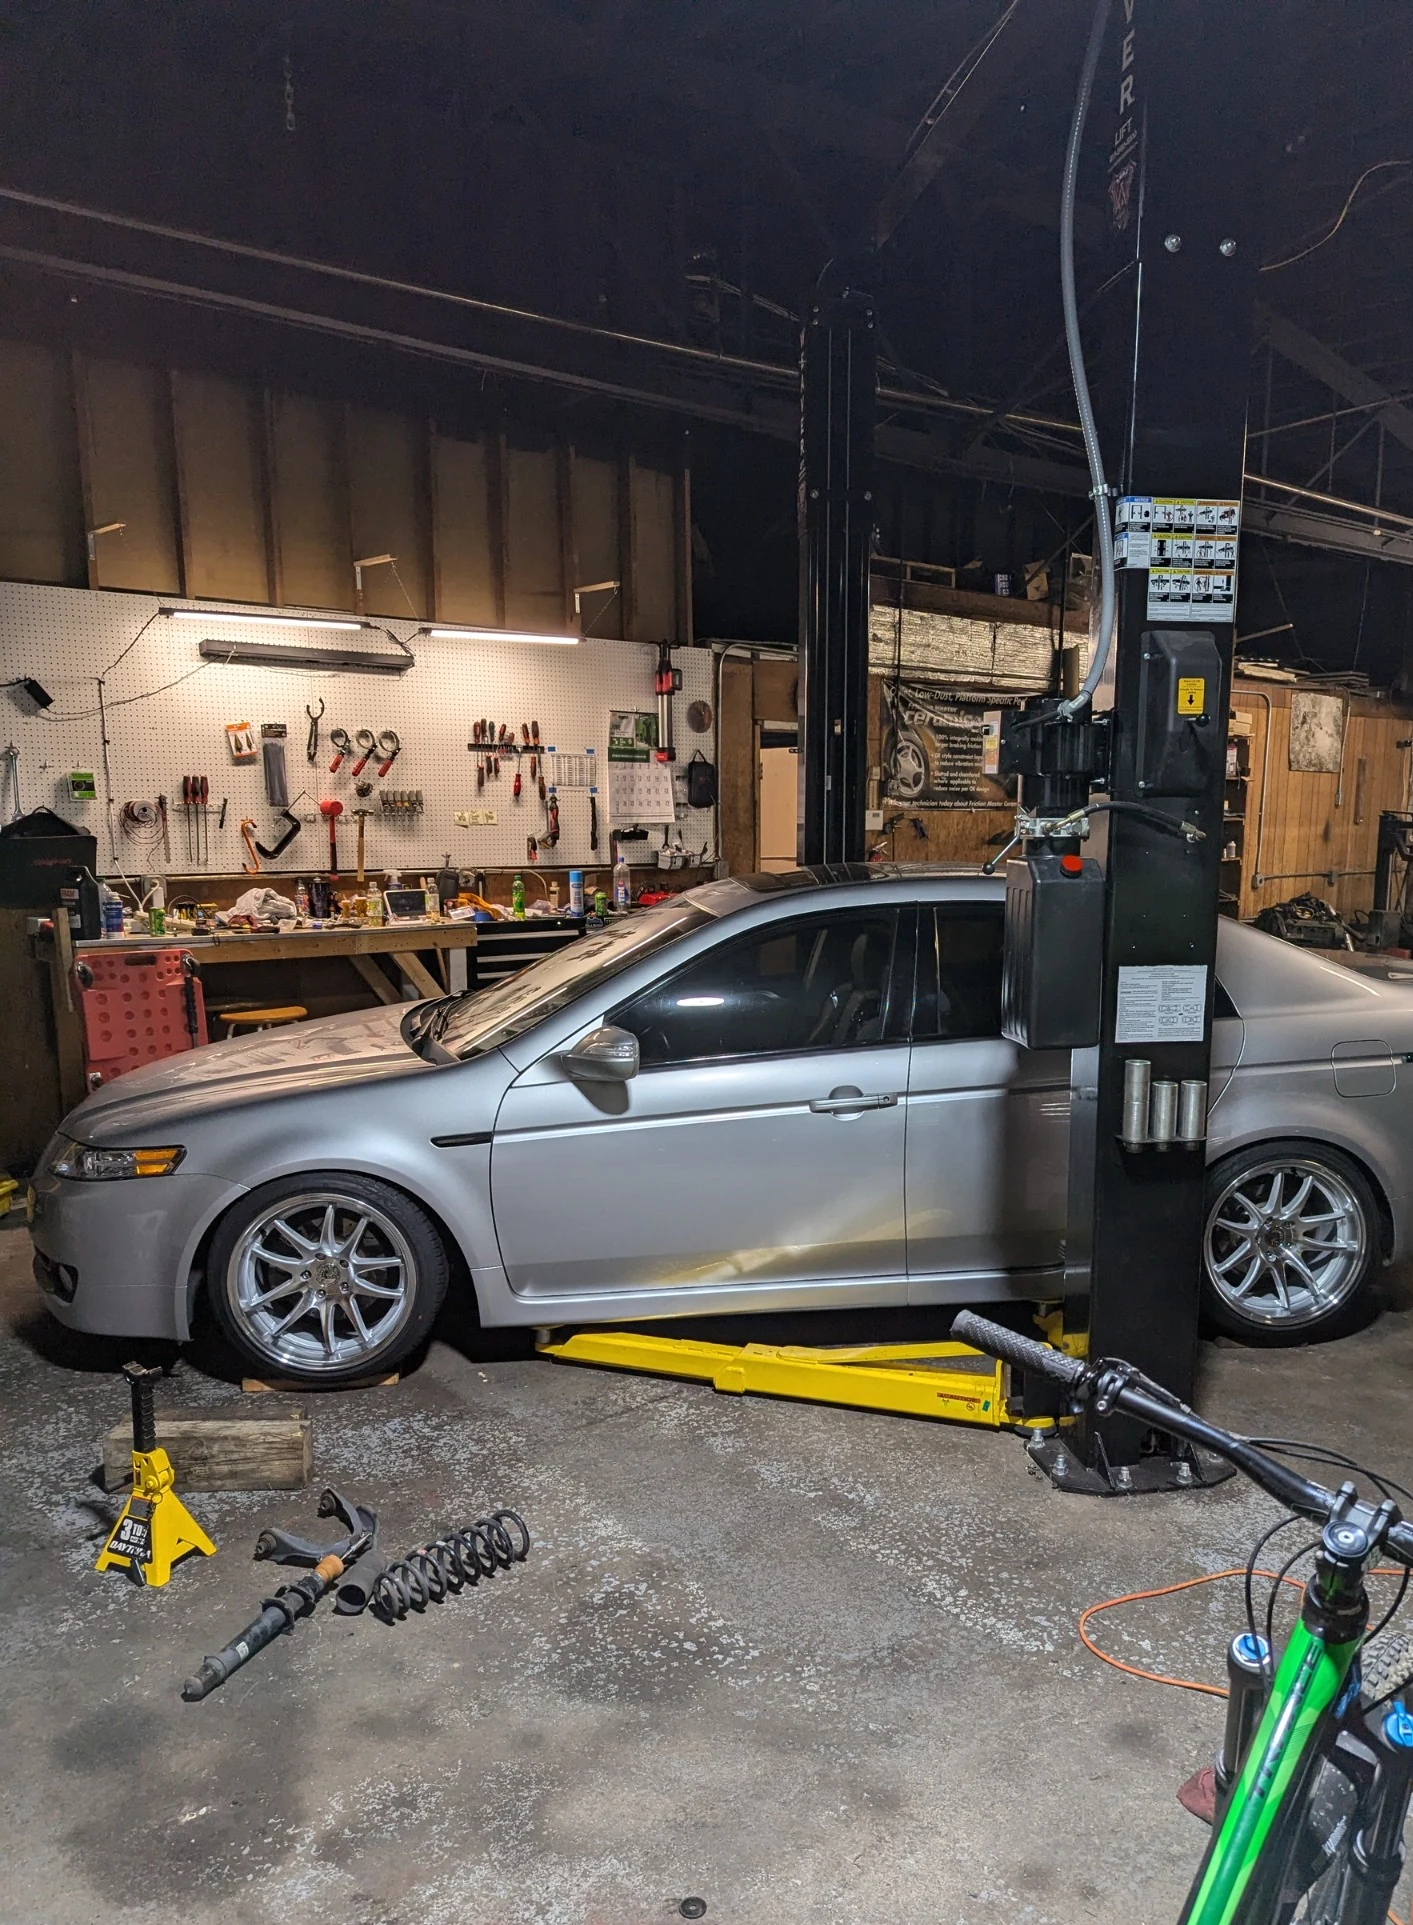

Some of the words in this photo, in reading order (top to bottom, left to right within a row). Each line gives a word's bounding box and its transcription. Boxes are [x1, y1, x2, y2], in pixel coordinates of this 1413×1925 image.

[1115, 117, 1133, 146] LIFT
[915, 689, 954, 702] Low-Dust,
[955, 692, 985, 703] Platform
[987, 696, 1013, 706] Specific
[120, 1518, 133, 1540] 3
